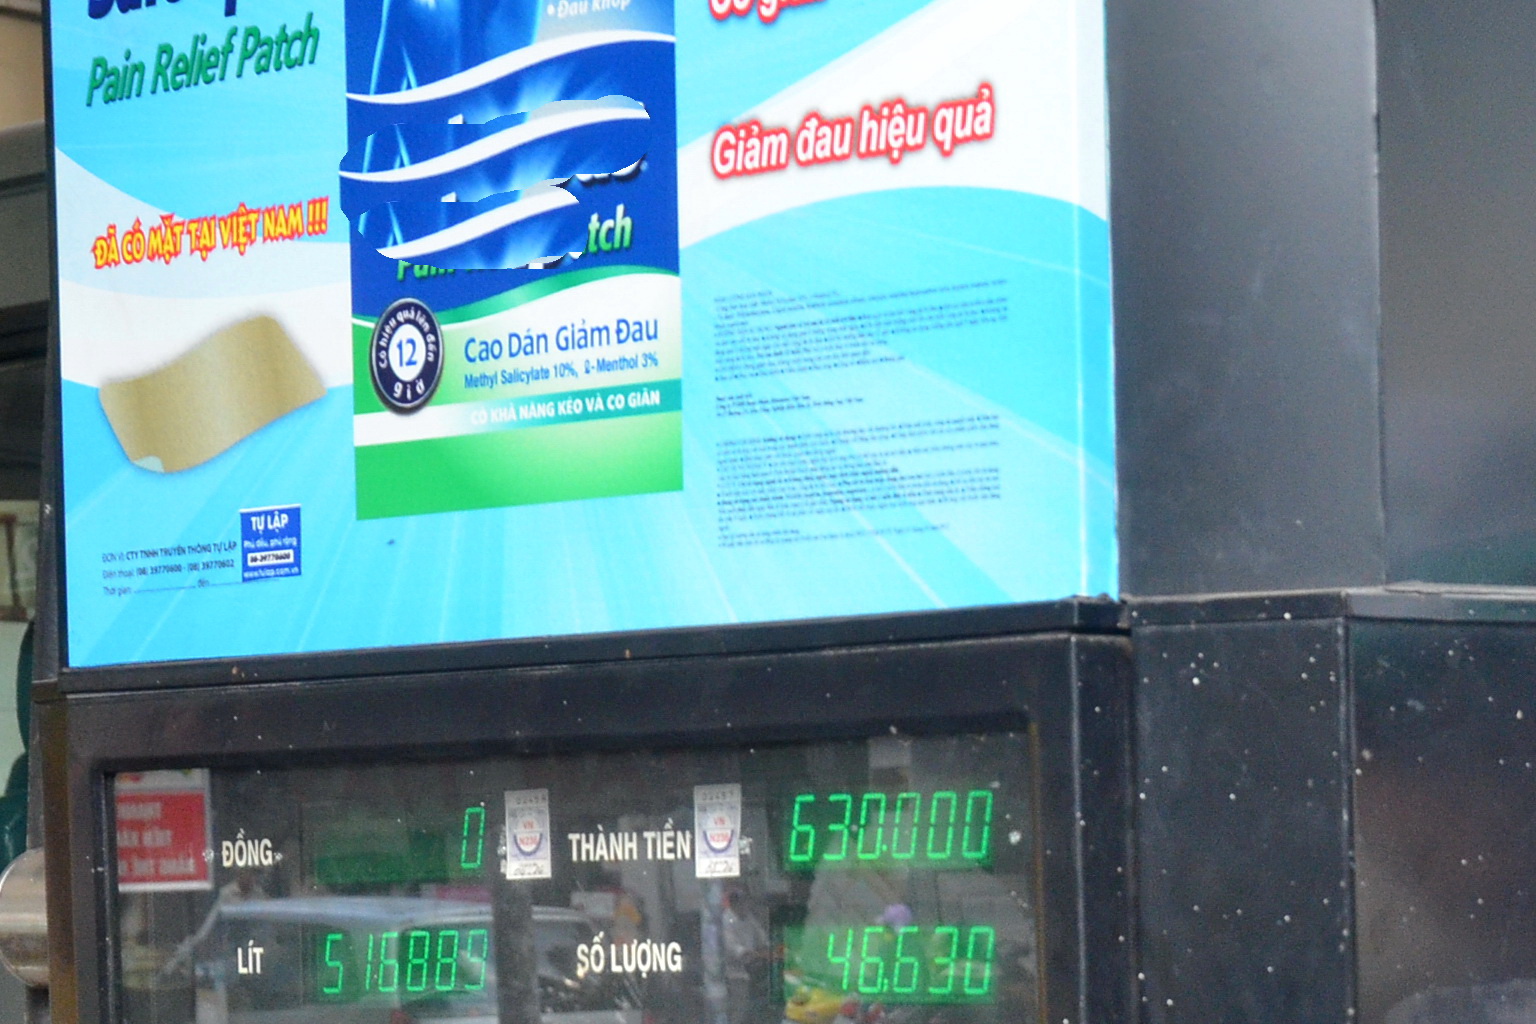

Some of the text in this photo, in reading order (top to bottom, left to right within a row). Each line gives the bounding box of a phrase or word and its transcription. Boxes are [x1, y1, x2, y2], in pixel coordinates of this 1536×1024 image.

[86, 11, 320, 107] Pain Relief Patch
[712, 83, 994, 177] Giảm đau hiệu quả
[93, 196, 329, 269] ĐÃ CÓ MẶT TẠI VIỆT NAM !!!
[396, 338, 417, 367] 12
[464, 318, 659, 363] Cao Dán Giảm Đau
[464, 371, 498, 389] Methyl
[501, 365, 550, 386] Salicylate
[642, 352, 660, 368] 3%
[586, 392, 605, 412] VÀ
[607, 391, 626, 409] CO
[222, 829, 274, 867] ĐỒNG
[460, 807, 486, 869] 0
[568, 817, 692, 861] THÀNH TIỀN
[237, 940, 264, 975] LÍT
[576, 932, 683, 979] SỐ LƯỢNG
